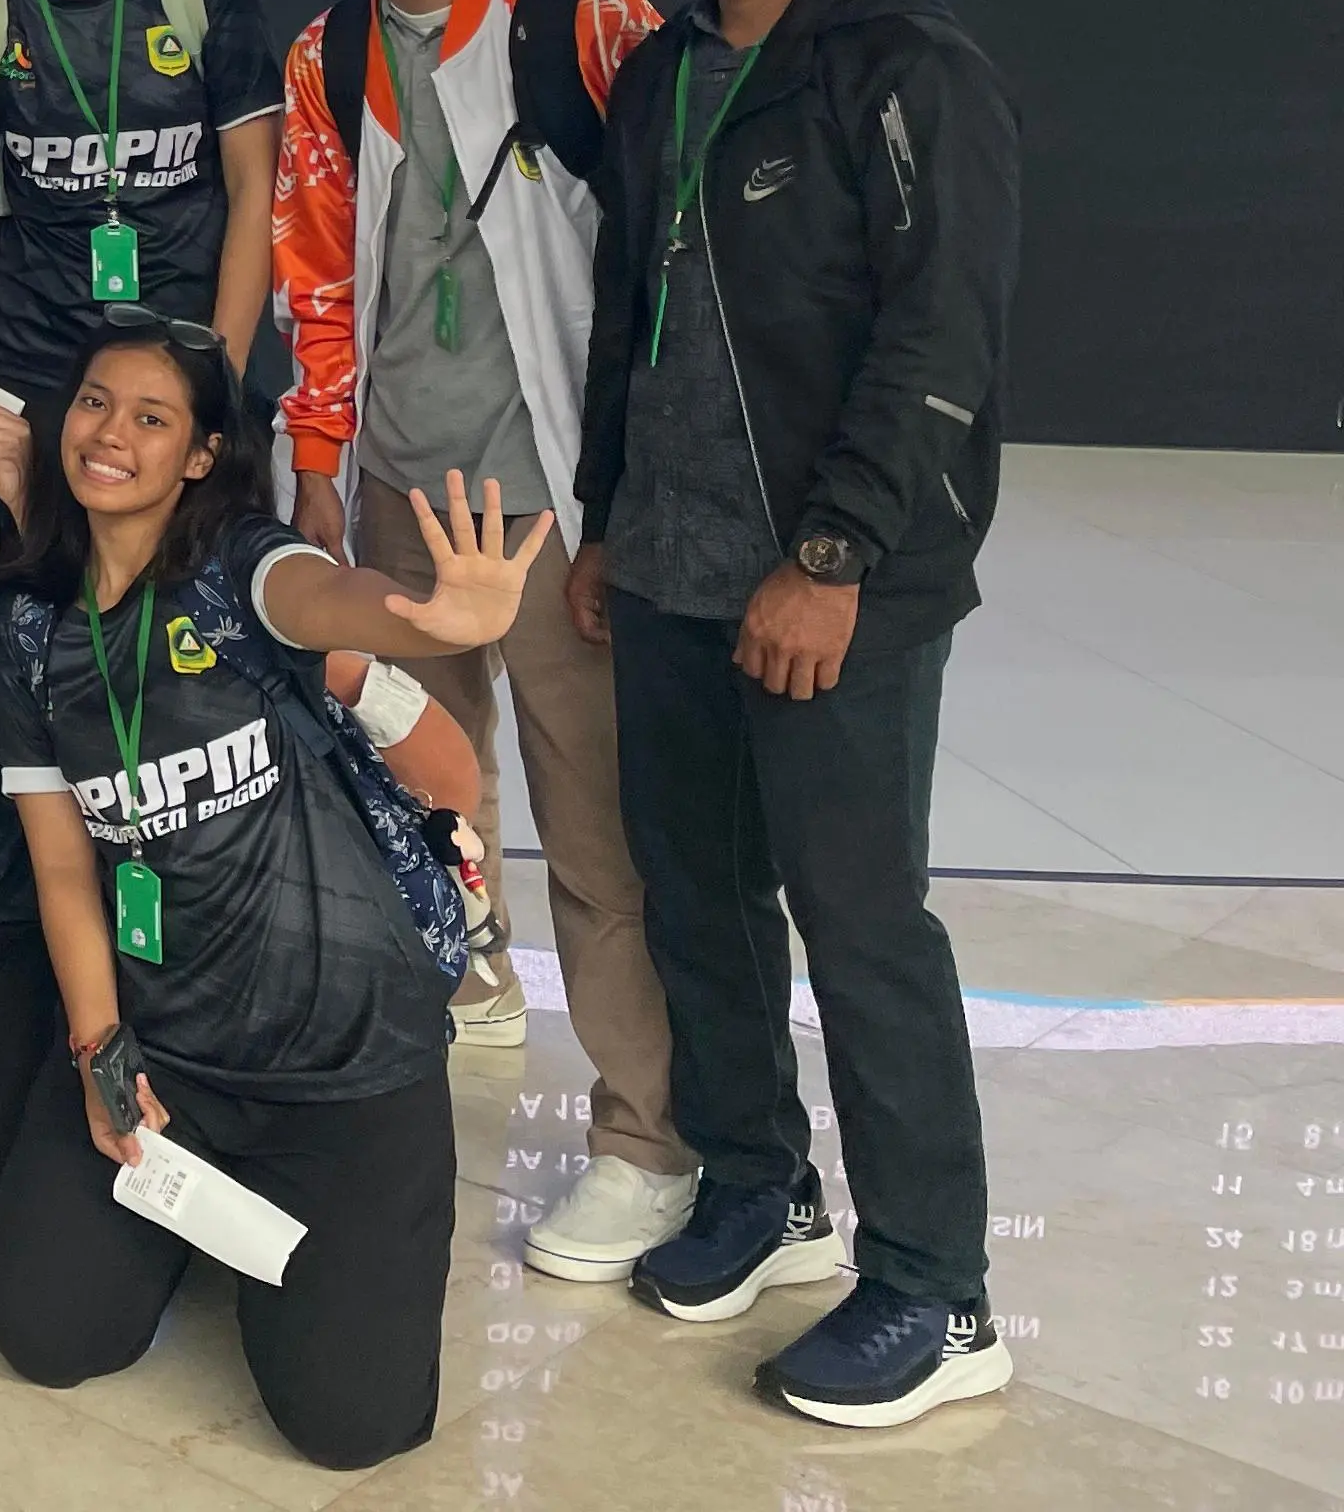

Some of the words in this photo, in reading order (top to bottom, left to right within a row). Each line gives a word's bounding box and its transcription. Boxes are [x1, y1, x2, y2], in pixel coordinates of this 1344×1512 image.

[70, 717, 271, 823] POPM
[197, 765, 280, 822] BOGOR
[781, 1202, 815, 1245] IKE
[942, 1313, 978, 1358] IKE
